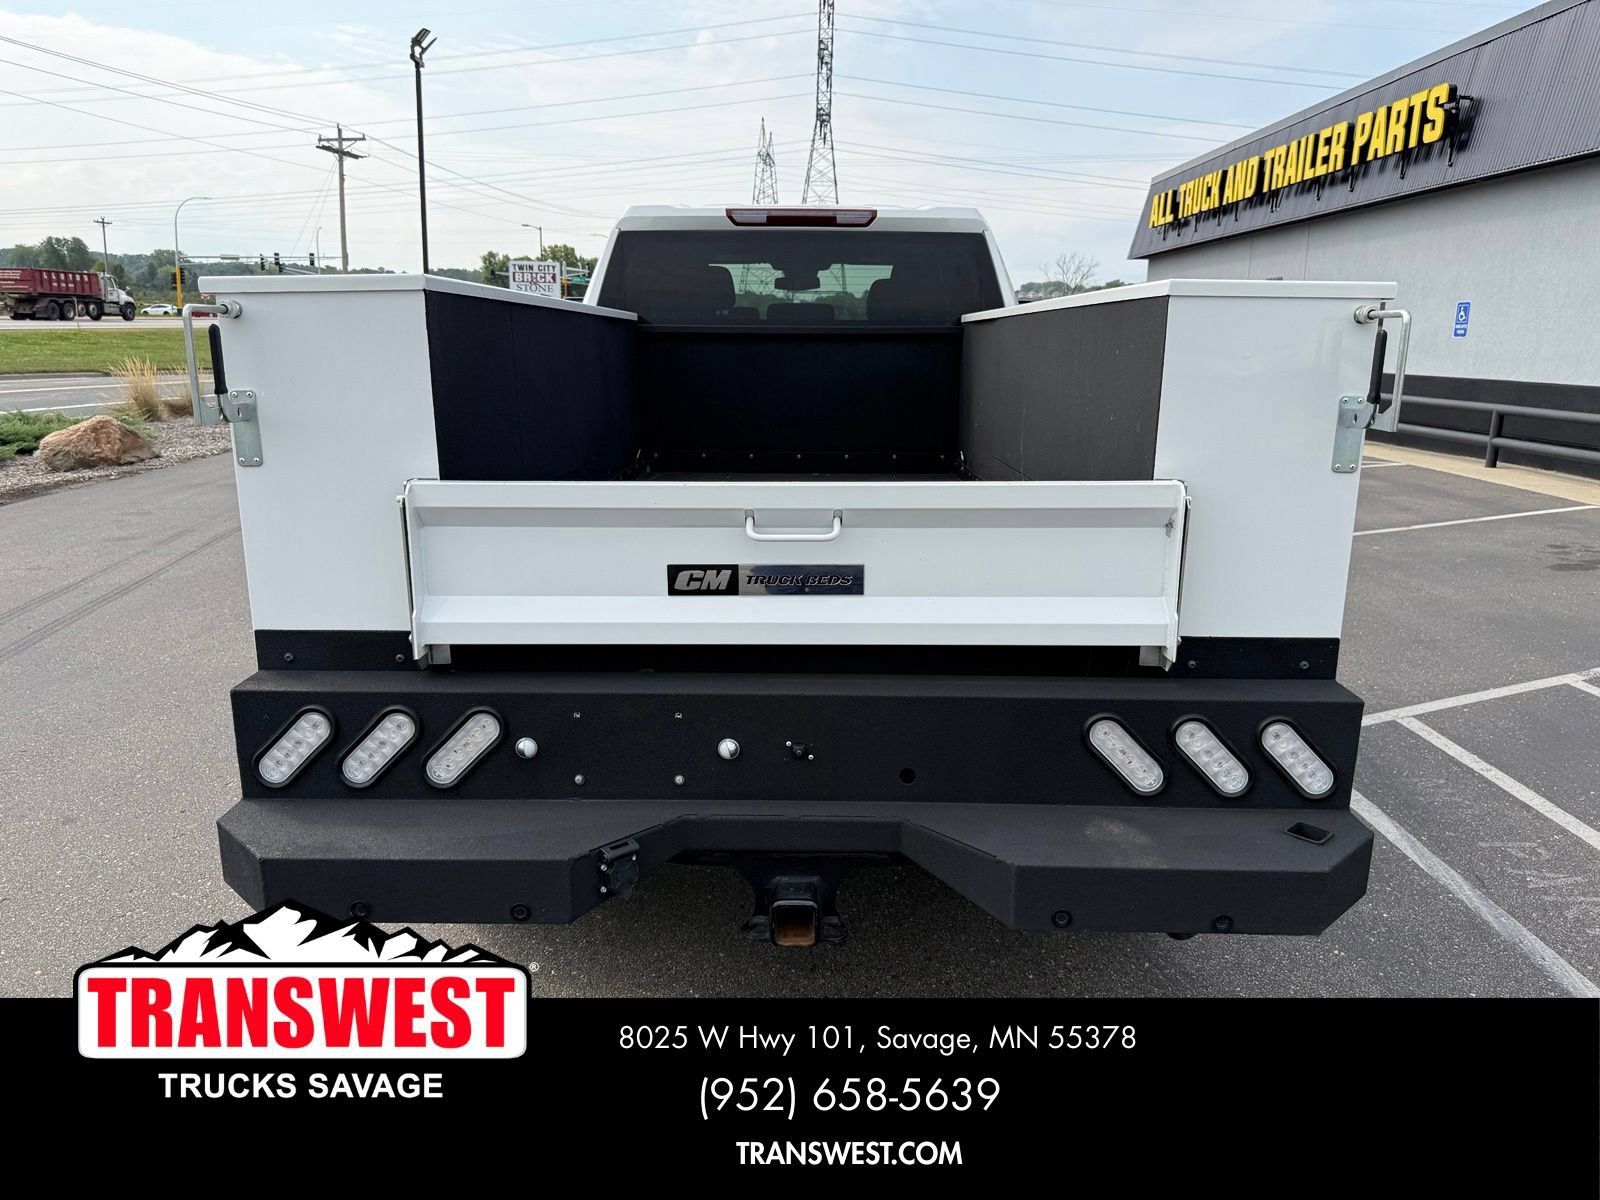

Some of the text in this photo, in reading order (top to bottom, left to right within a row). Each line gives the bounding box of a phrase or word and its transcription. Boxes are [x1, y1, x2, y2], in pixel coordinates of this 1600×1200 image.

[1149, 82, 1450, 228] ALL TRUCK AND TRAILER PARTS
[512, 264, 556, 273] TWIN CITY
[514, 273, 555, 283] BRICK
[516, 284, 554, 293] STONE
[673, 569, 733, 591] CM
[745, 575, 853, 586] TRUCK BEDS
